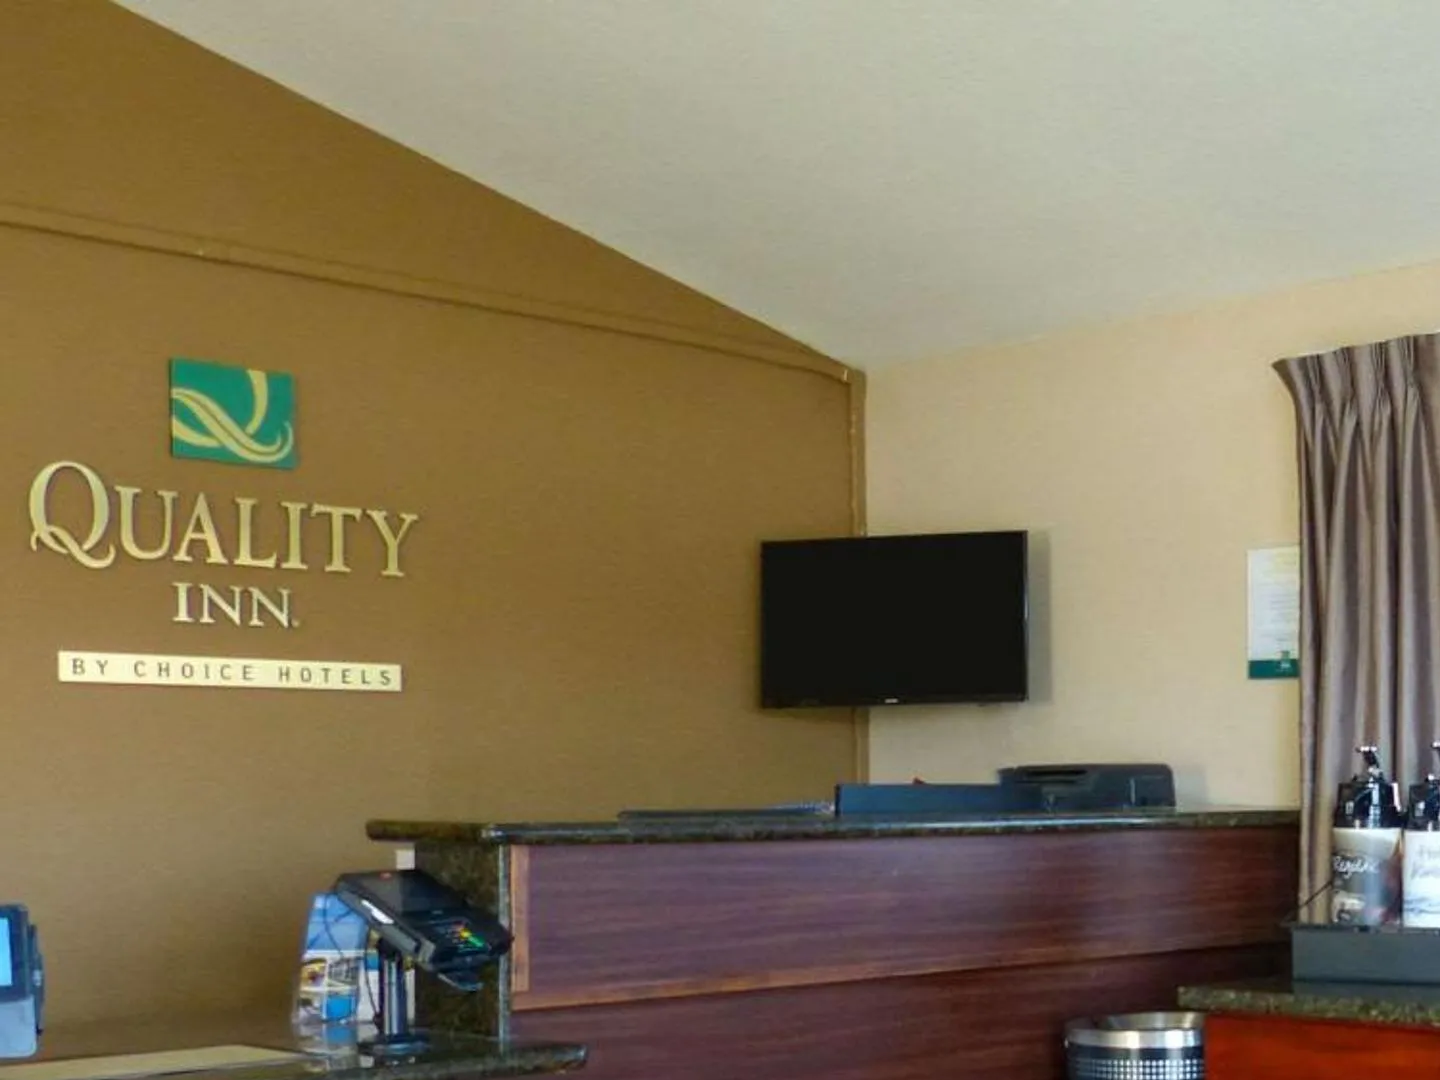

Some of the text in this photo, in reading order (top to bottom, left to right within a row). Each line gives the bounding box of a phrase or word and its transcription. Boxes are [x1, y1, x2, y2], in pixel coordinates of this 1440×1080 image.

[29, 460, 419, 577] QUALITY
[172, 582, 291, 629] INN
[72, 658, 393, 686] BY CHOICE HOTELS
